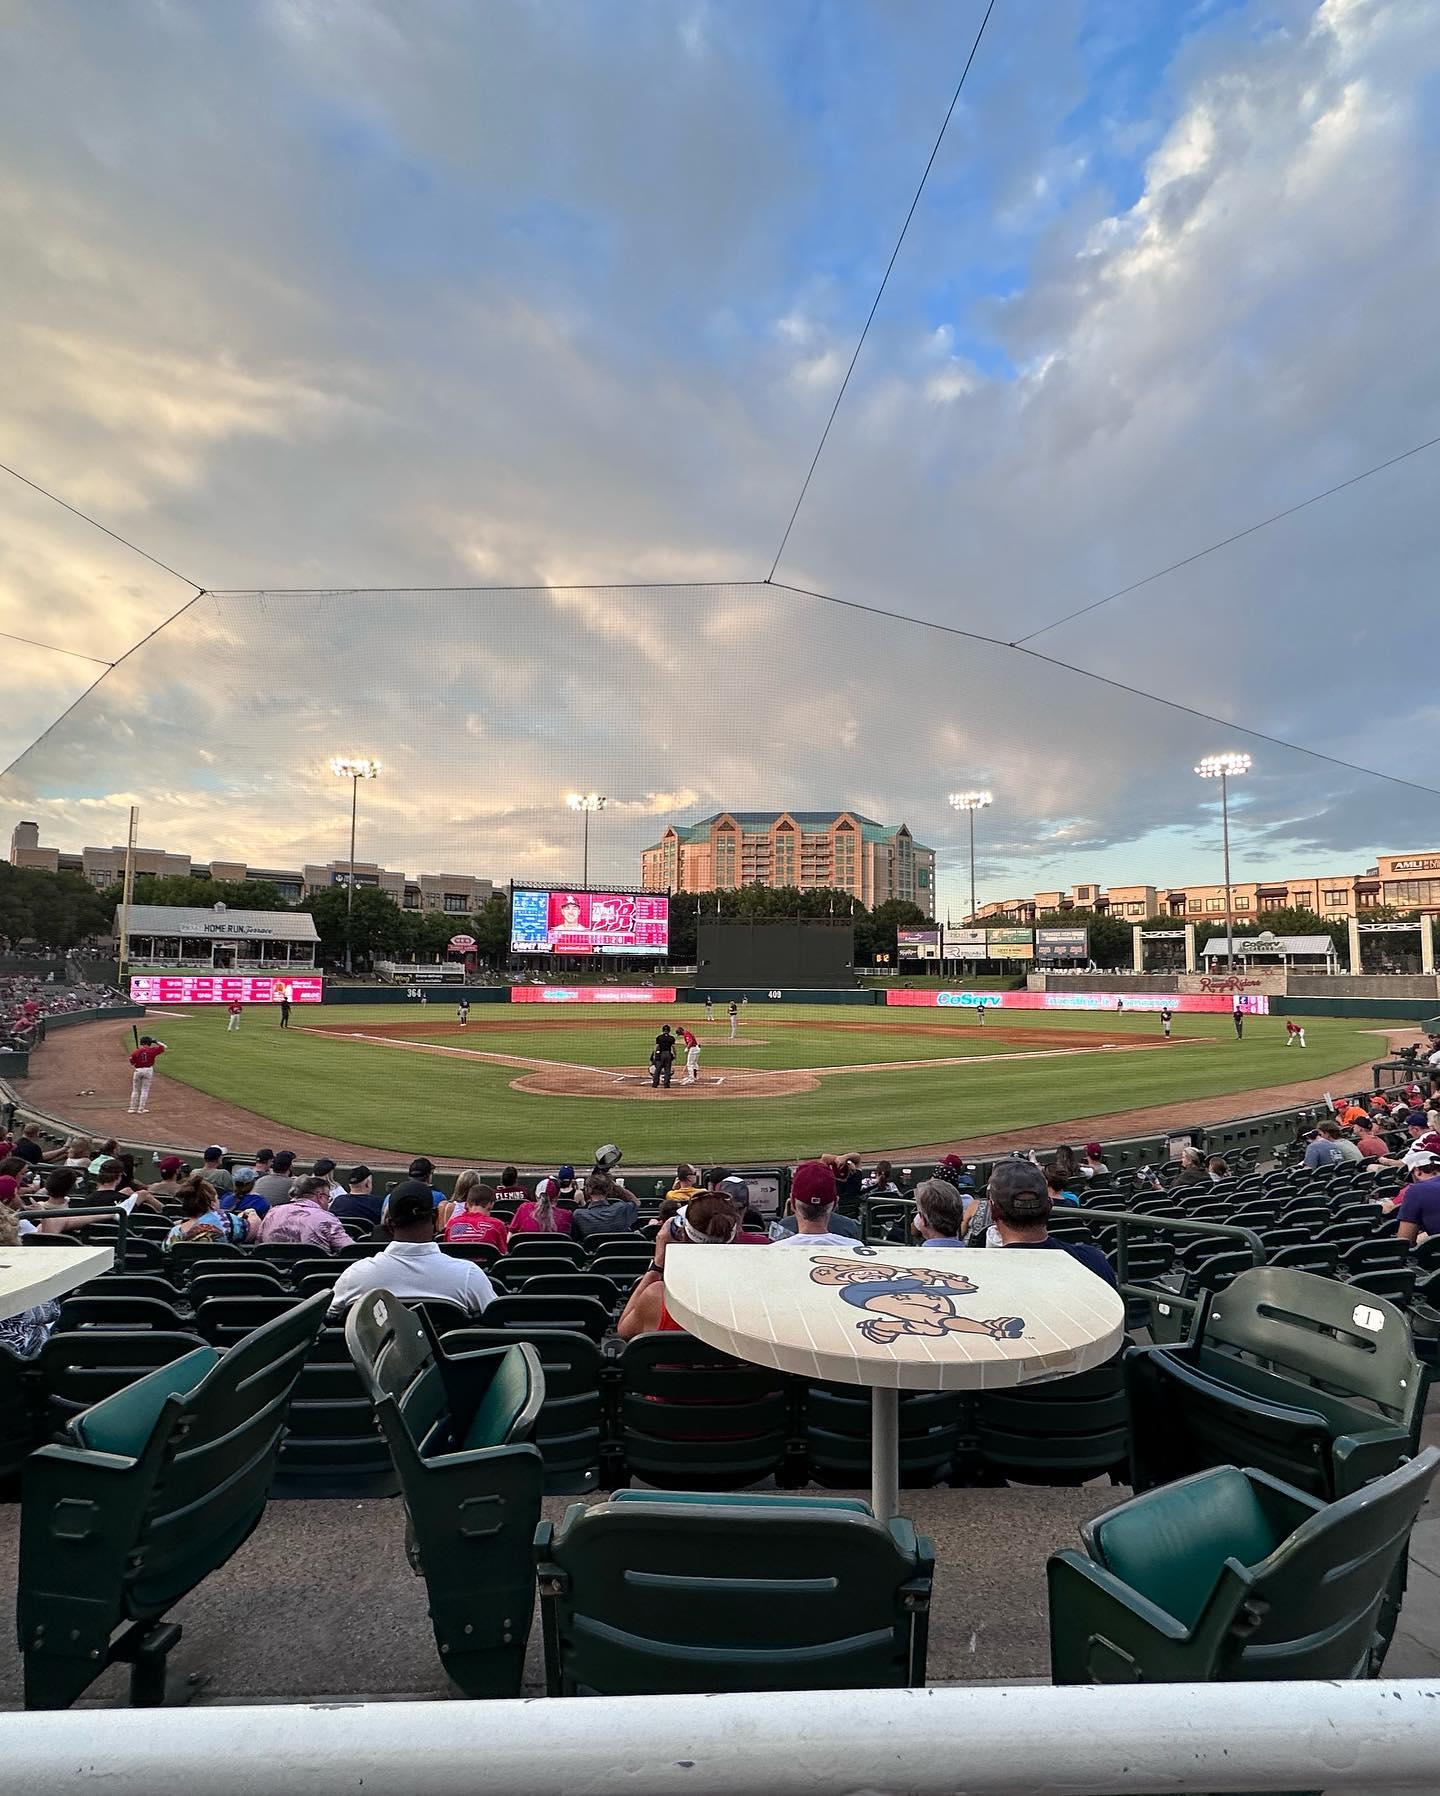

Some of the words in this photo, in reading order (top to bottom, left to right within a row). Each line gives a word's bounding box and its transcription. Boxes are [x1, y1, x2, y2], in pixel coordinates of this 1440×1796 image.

[1395, 861, 1422, 870] AMLI
[204, 924, 225, 933] HOME
[227, 925, 243, 934] RUN
[407, 989, 421, 998] 364
[937, 993, 1001, 1006] CoServ
